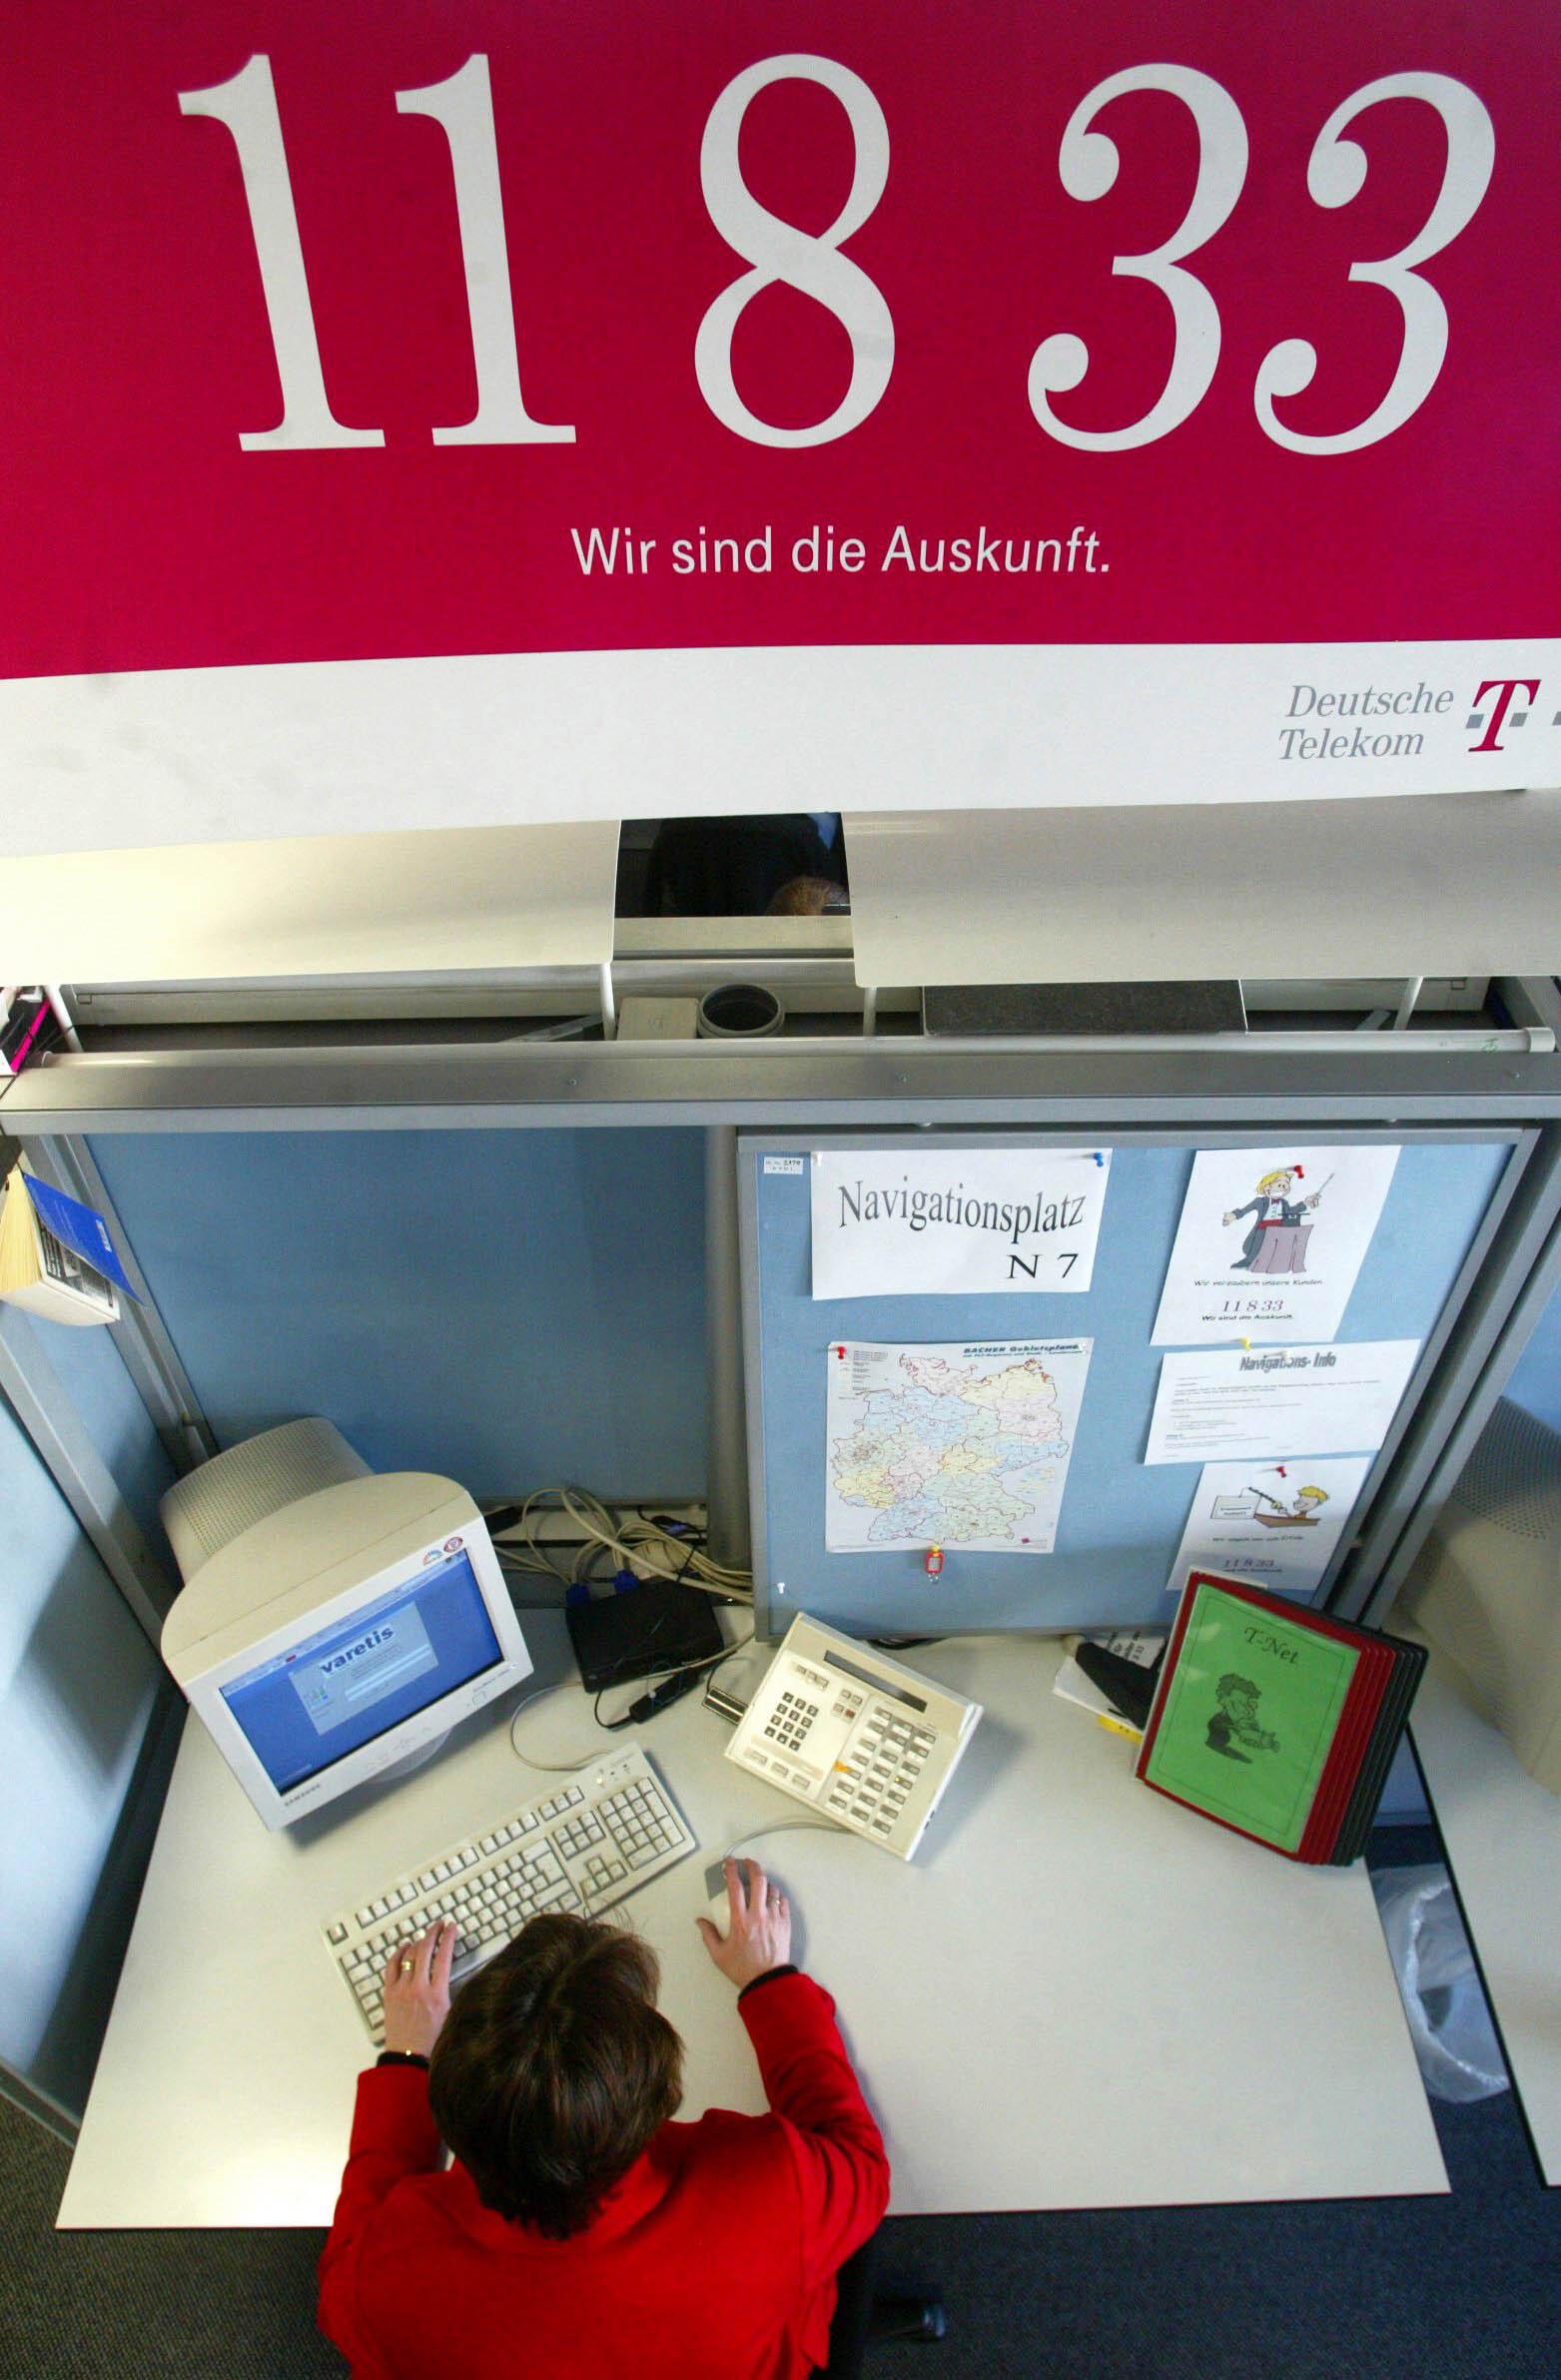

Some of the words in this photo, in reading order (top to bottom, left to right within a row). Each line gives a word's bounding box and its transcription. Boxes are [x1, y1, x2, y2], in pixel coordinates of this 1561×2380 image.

[178, 53, 577, 451] 11
[694, 53, 896, 449] 8
[1027, 62, 1496, 455] 33
[570, 526, 656, 576] Wir
[671, 524, 772, 574] sind
[791, 525, 866, 573] die
[881, 524, 1111, 573] Auskunft.
[1285, 682, 1455, 717] Deutsche
[1278, 727, 1424, 760] Telekom
[838, 1175, 1087, 1244] Navigationsplatz
[1007, 1253, 1043, 1279] N
[1057, 1252, 1079, 1279] 7
[1222, 1300, 1241, 1312] 11
[1245, 1299, 1258, 1312] 8
[1260, 1299, 1284, 1311] 33
[1312, 1350, 1337, 1368] Info
[321, 1626, 394, 1674] varetis
[1243, 1626, 1299, 1665] T-Net
